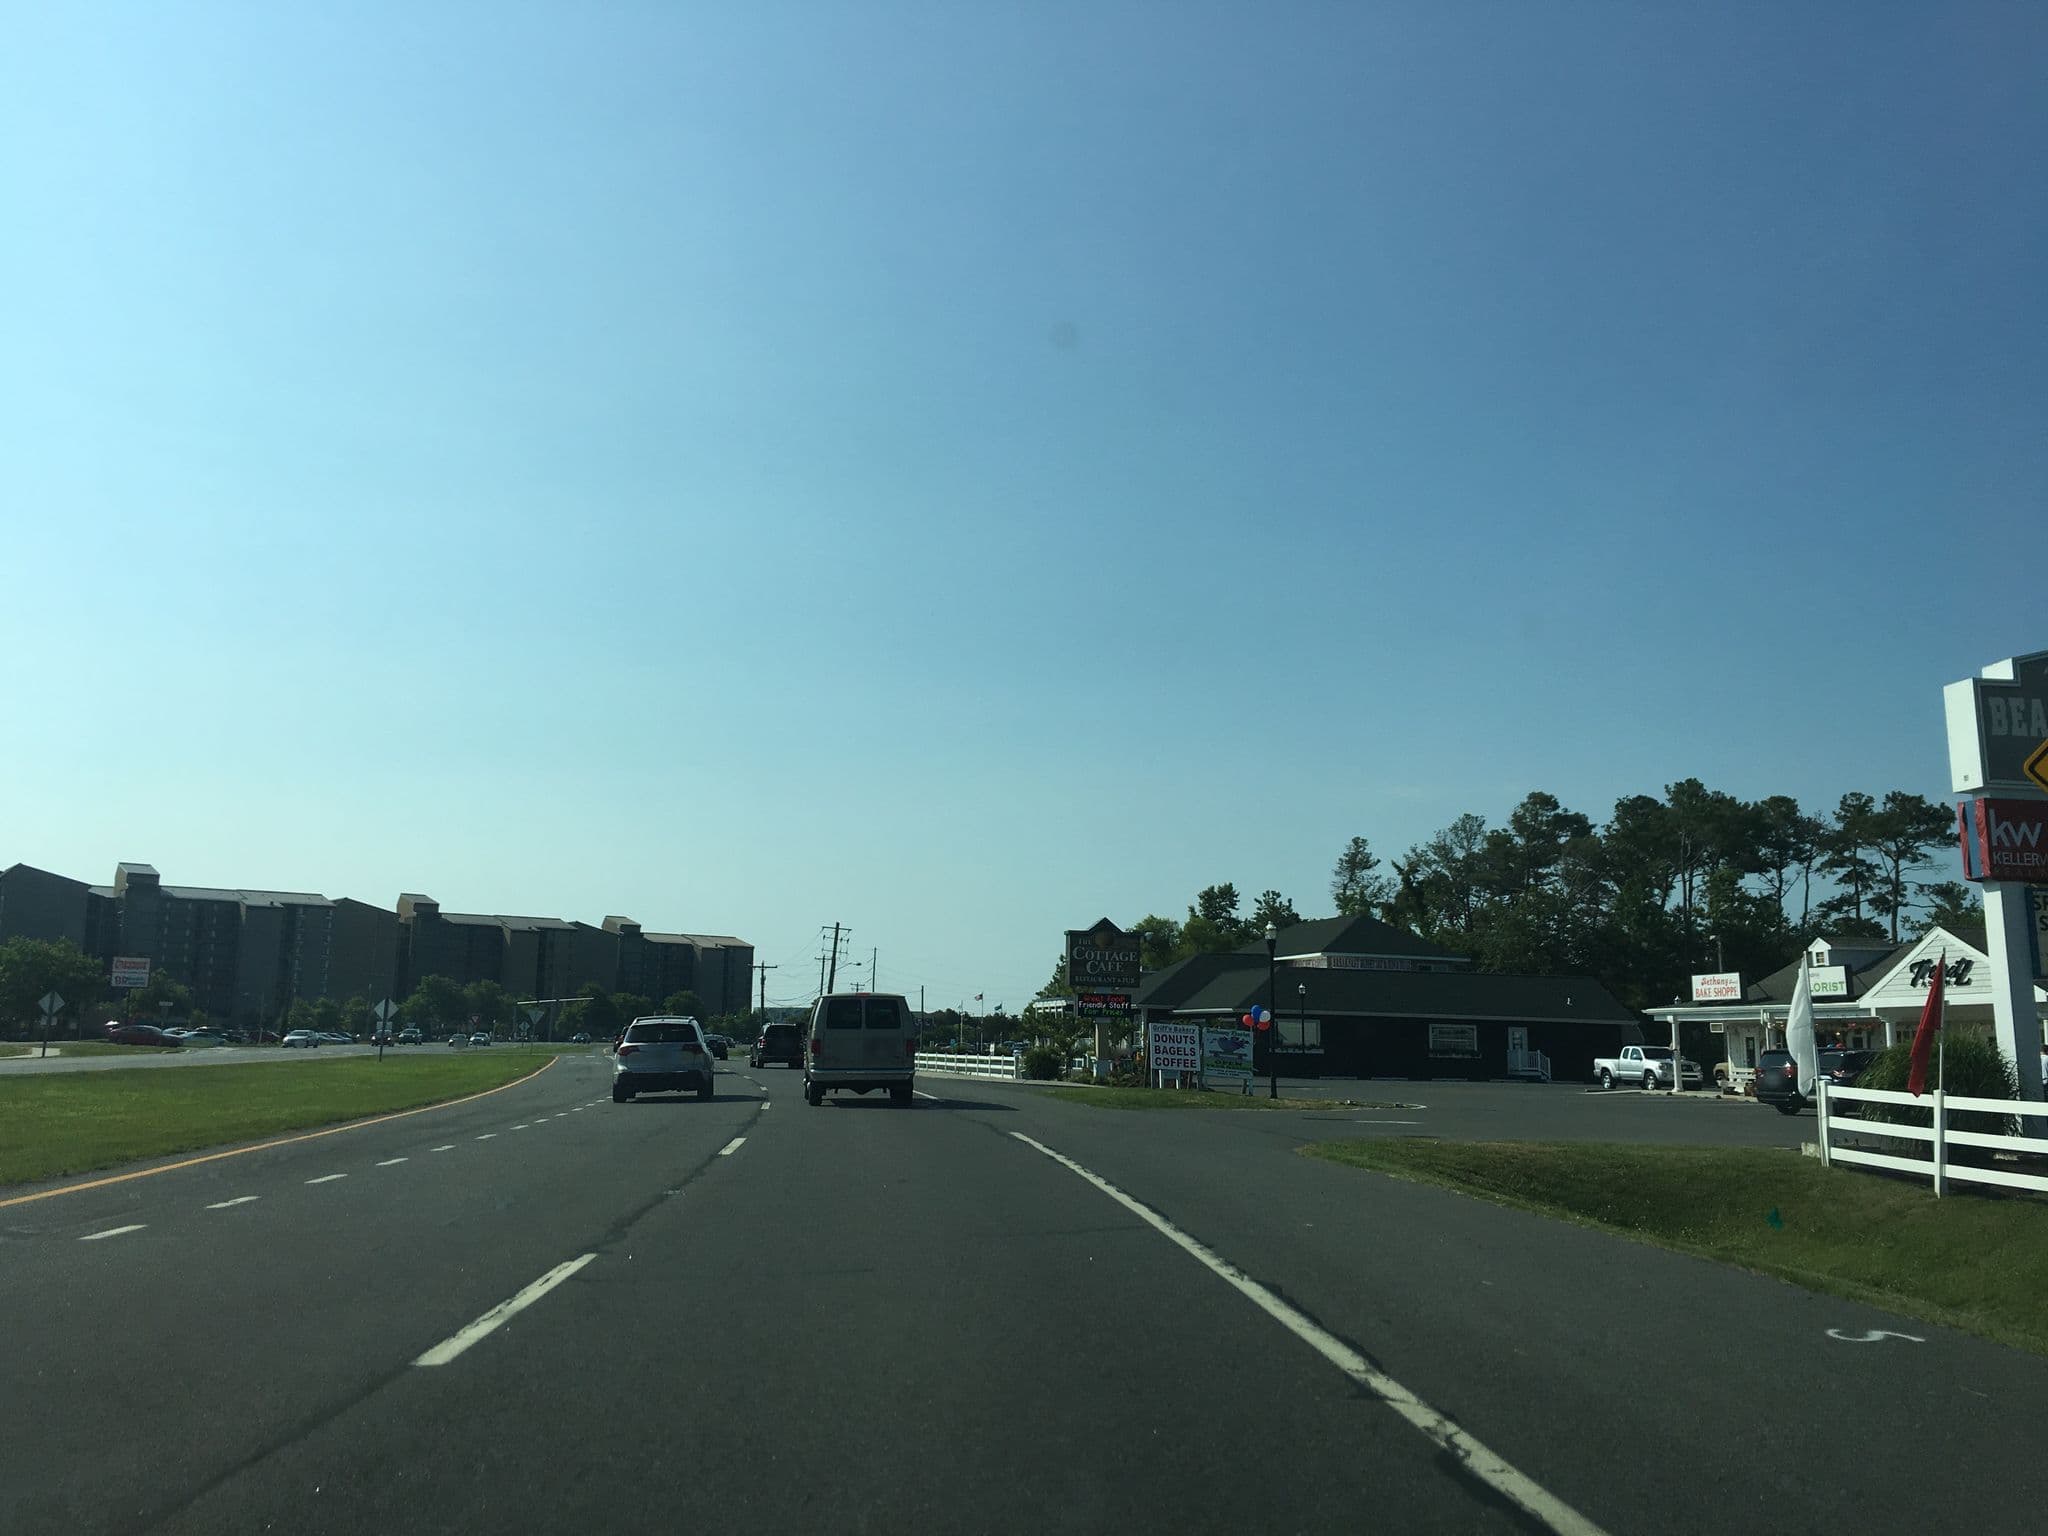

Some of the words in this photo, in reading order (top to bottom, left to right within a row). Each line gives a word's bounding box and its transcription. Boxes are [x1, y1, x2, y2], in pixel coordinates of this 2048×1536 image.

[1993, 852, 2039, 866] KELLER
[1695, 988, 1712, 998] BAKE
[1154, 1033, 1196, 1045] DONUTS
[1154, 1045, 1196, 1056] BAGELS
[1155, 1057, 1197, 1068] COFFEE
